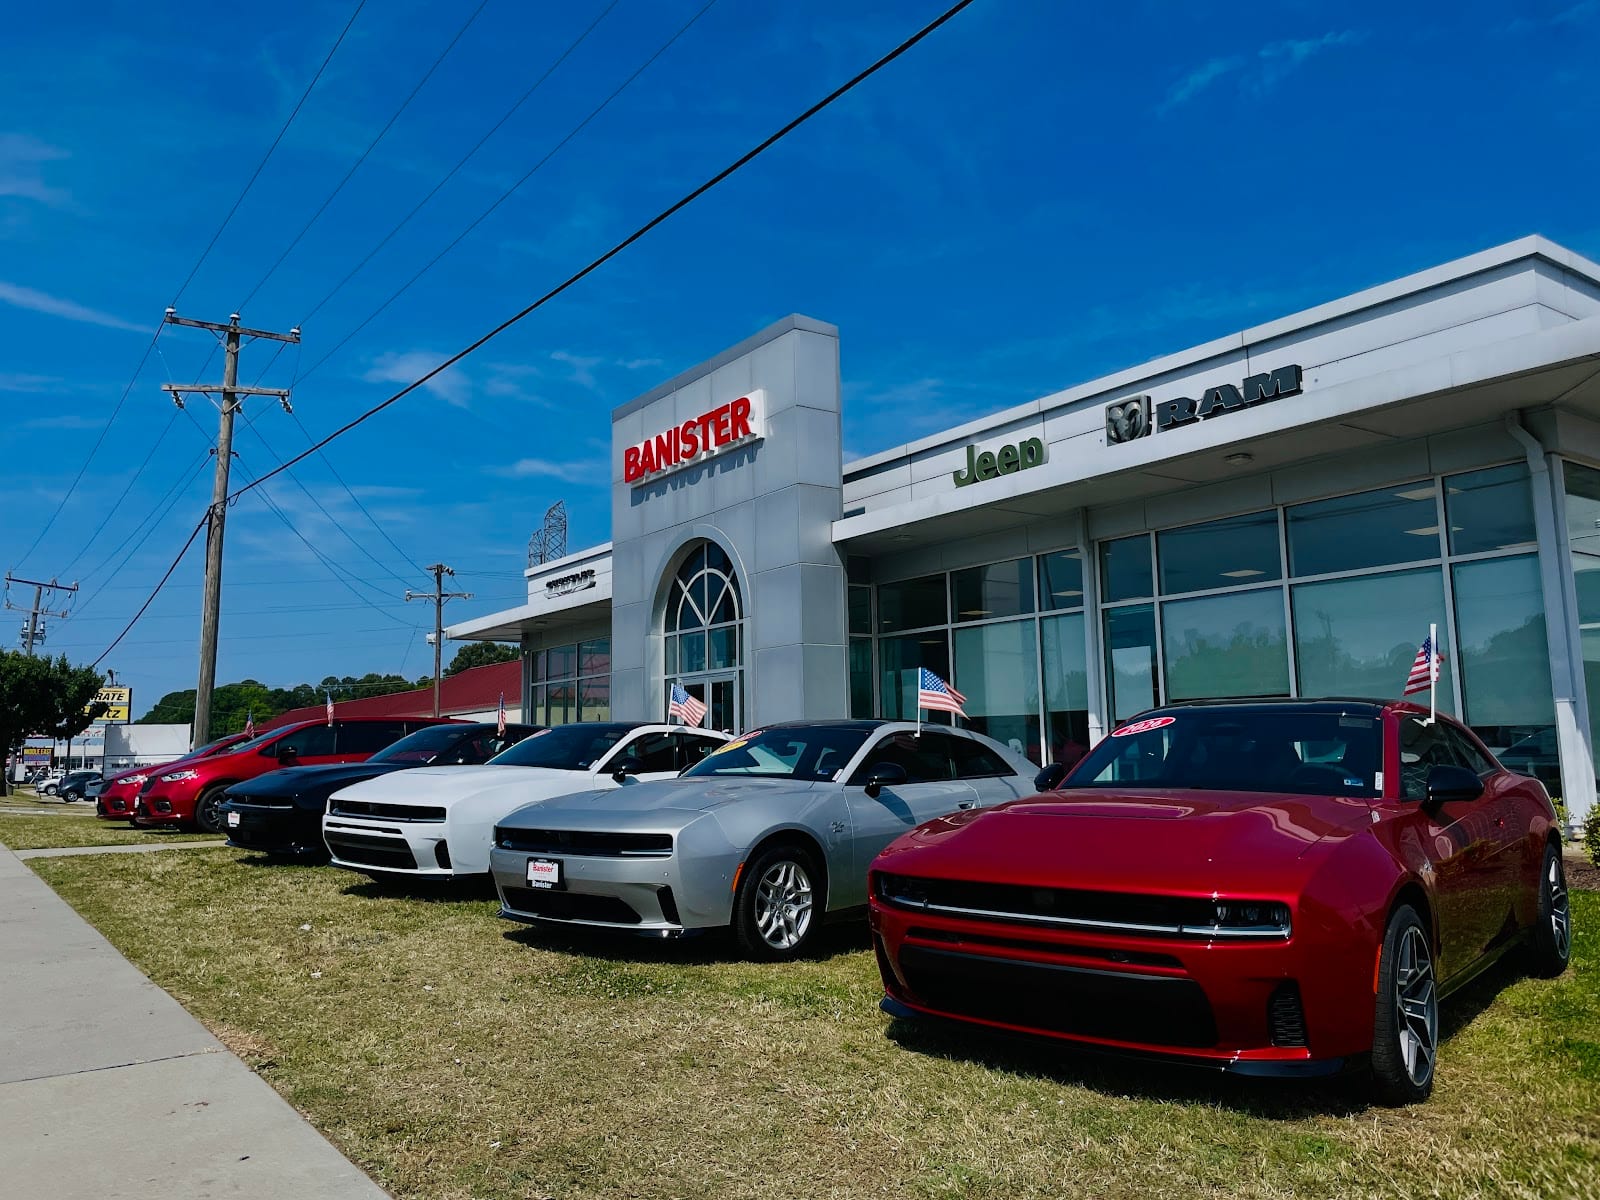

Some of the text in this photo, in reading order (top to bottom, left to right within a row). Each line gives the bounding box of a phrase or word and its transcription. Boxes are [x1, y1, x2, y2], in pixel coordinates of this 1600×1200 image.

[1156, 364, 1302, 432] RAM
[624, 397, 751, 483] BANISTER
[953, 436, 1047, 488] Jeep
